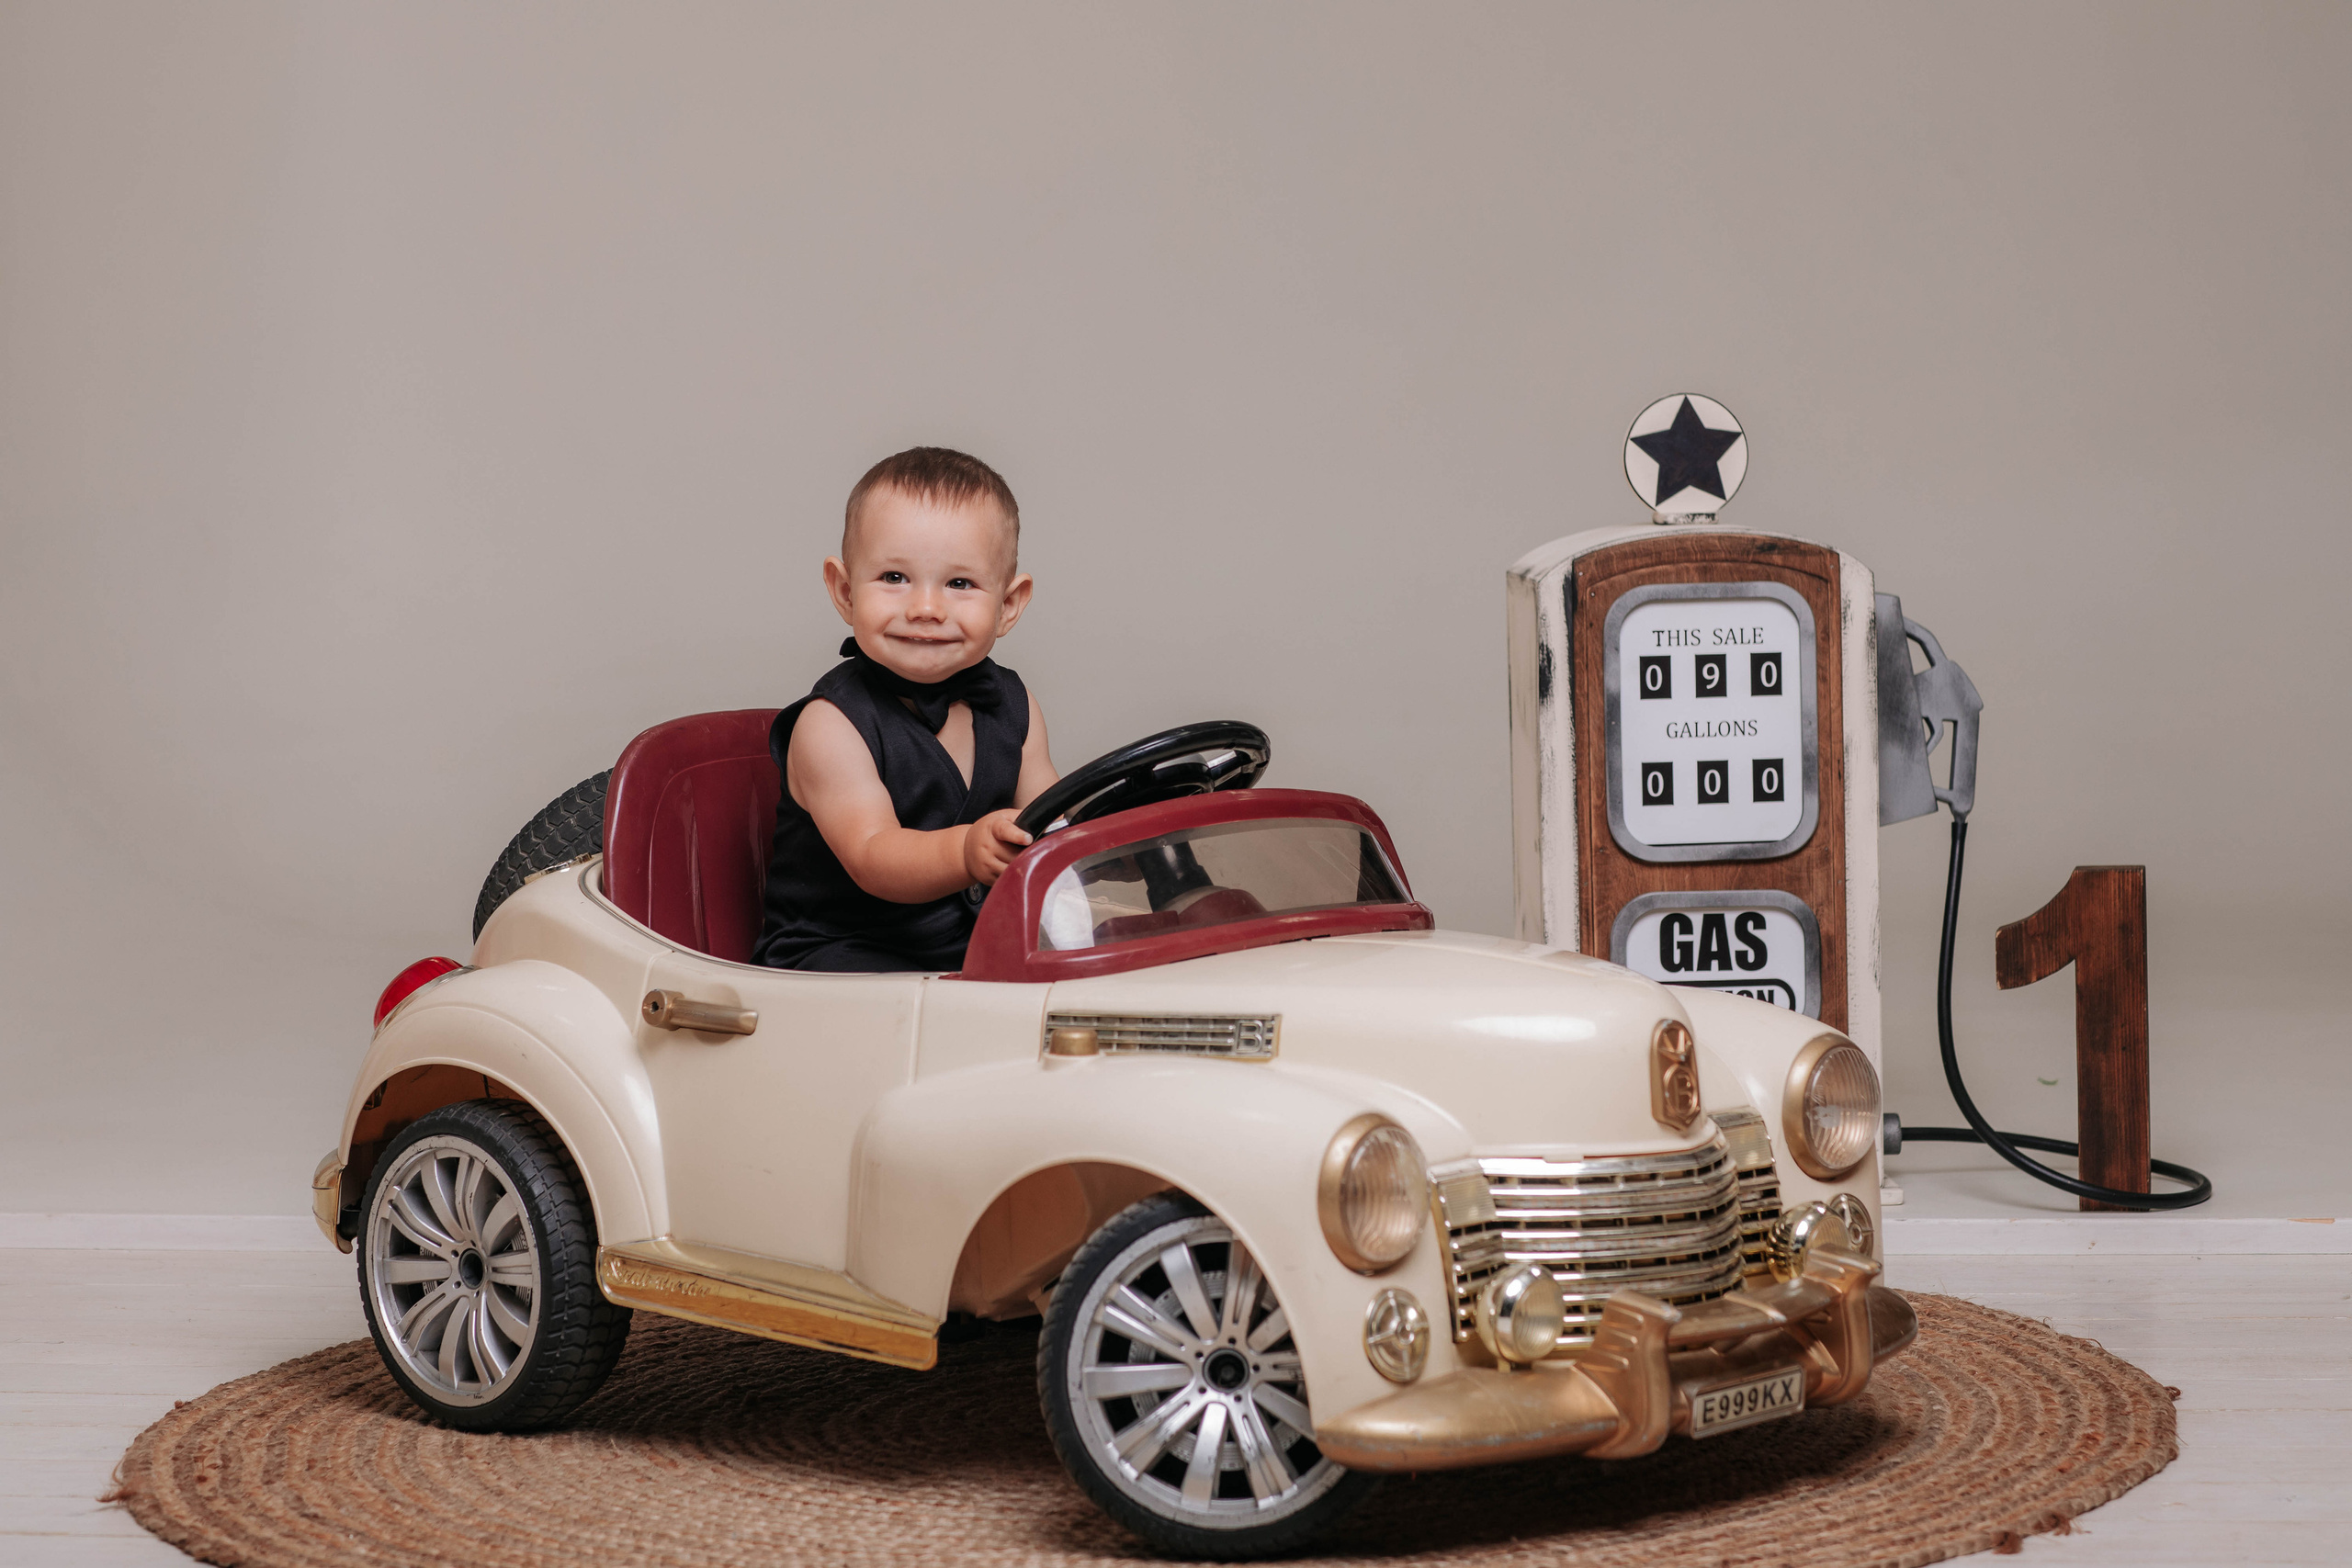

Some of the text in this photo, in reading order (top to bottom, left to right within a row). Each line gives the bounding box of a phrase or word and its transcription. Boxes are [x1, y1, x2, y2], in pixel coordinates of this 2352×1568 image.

[1652, 627, 1765, 648] THIS SALE
[1645, 660, 1778, 692] 0 9 0
[1666, 719, 1758, 739] GALLONS
[1646, 767, 1780, 798] 0 0 0
[1659, 911, 1769, 974] GAS
[1996, 865, 2151, 1213] 1
[1702, 1378, 1794, 1424] E999KX
